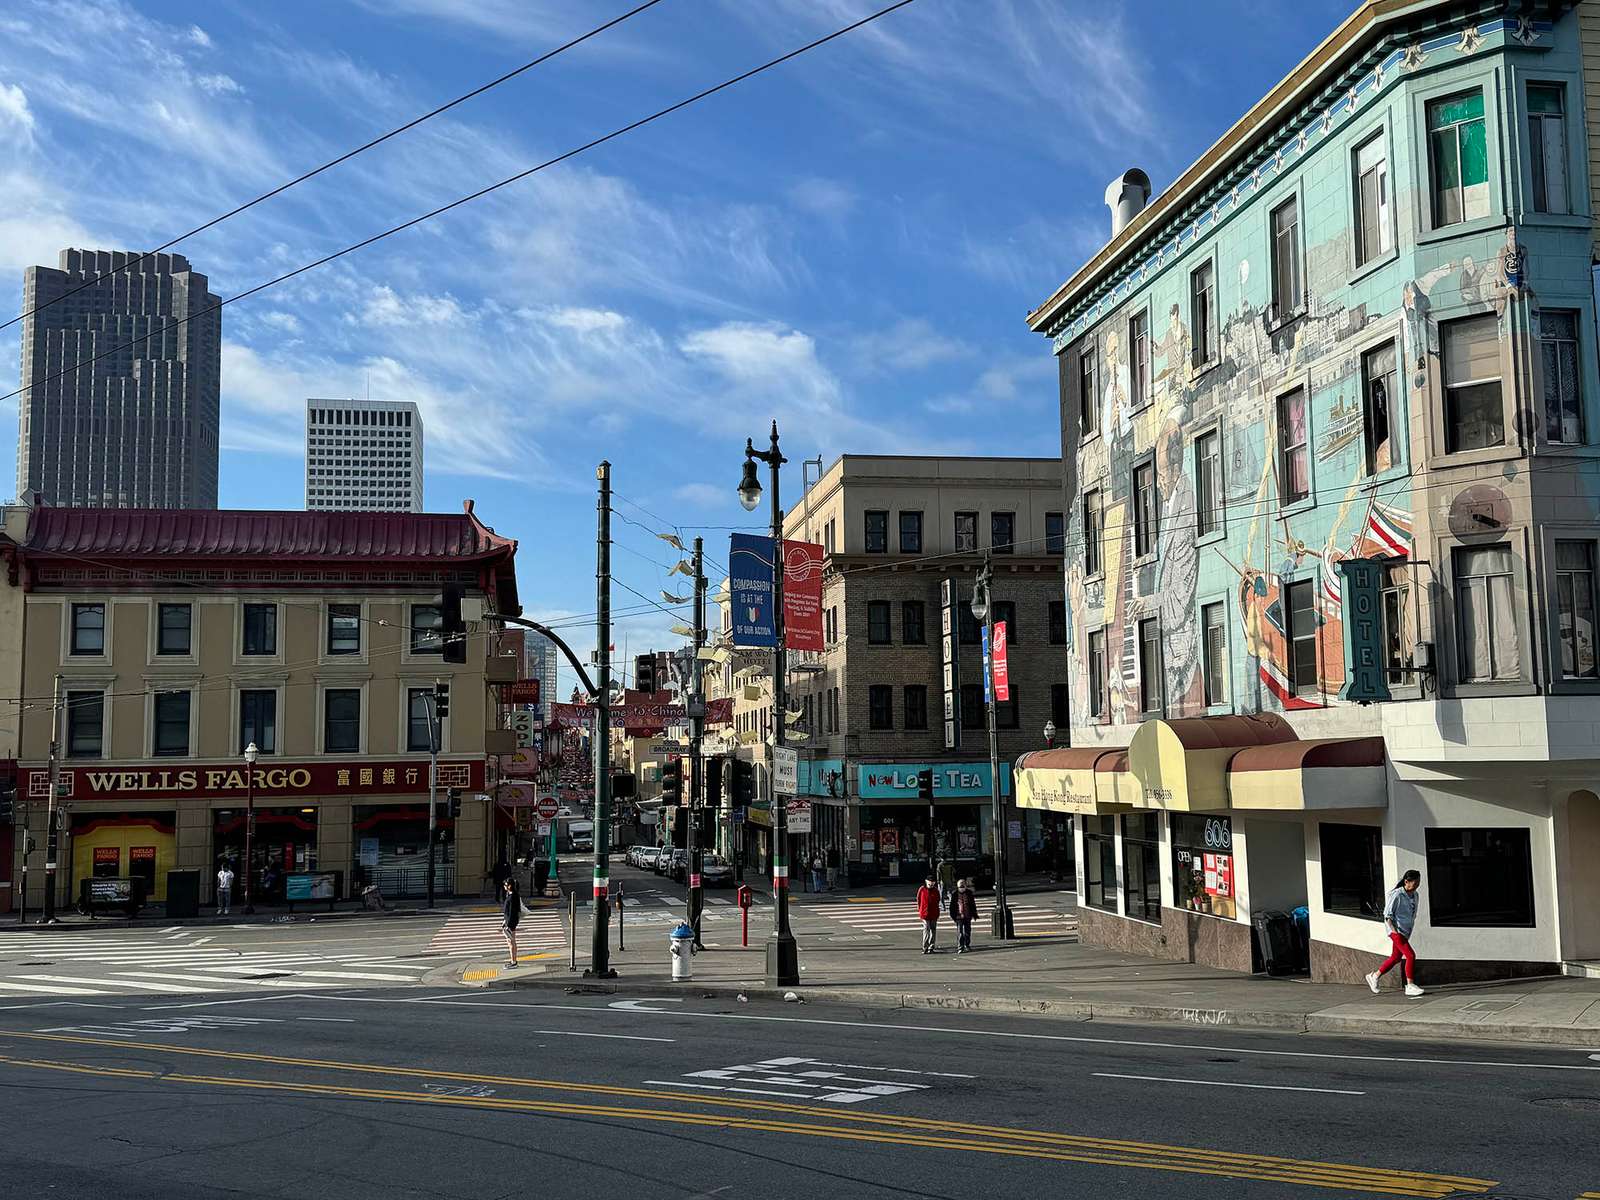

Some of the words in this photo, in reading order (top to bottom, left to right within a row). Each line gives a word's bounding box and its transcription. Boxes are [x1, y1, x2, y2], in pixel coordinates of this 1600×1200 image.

[733, 578, 771, 592] COMPASSION
[740, 593, 746, 604] IS
[754, 594, 763, 605] THE
[744, 625, 754, 635] OUR
[1356, 568, 1375, 694] HOTEL
[943, 612, 952, 744] HOTEL
[633, 705, 645, 716] to
[86, 770, 197, 791] WELLS
[205, 768, 312, 790] FARGO
[337, 768, 418, 786] 富國銀行
[893, 770, 941, 789] LOE
[946, 770, 982, 788] TEA
[1066, 790, 1092, 804] Restaurant
[1205, 818, 1231, 848] 606
[1177, 849, 1192, 863] OPEN
